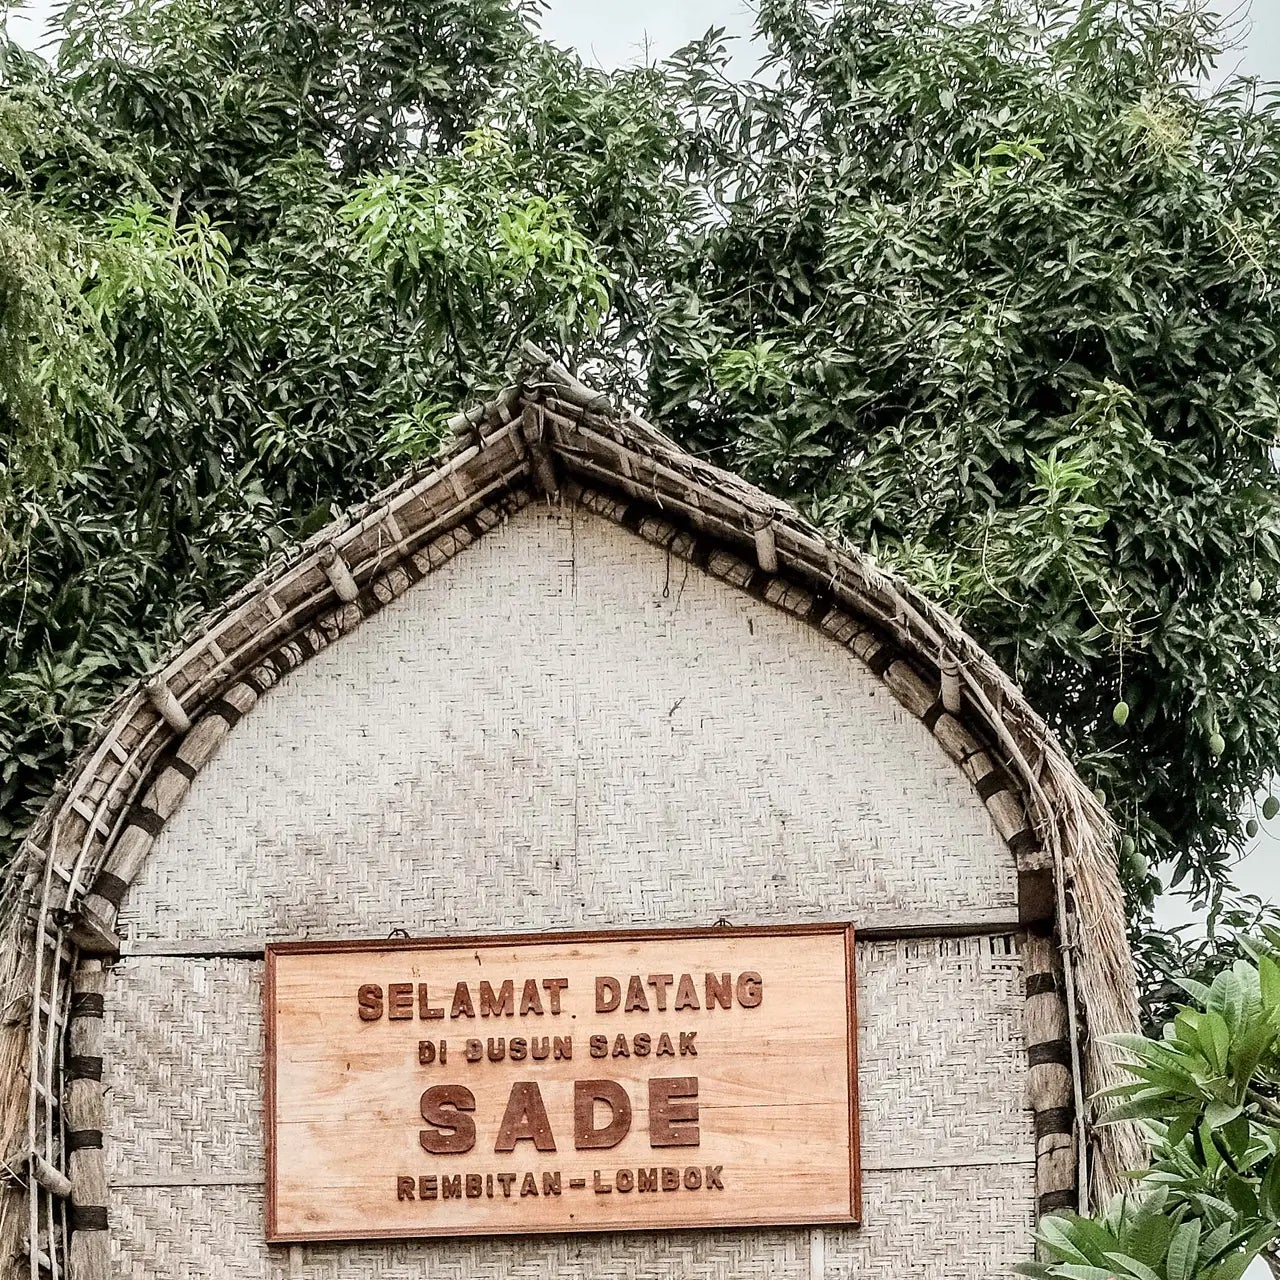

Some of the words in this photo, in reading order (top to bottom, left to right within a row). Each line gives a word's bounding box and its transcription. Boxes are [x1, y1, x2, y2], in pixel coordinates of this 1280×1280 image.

[357, 978, 569, 1021] SELAMAT
[595, 970, 763, 1015] DATANG
[418, 1039, 447, 1064] DI
[465, 1035, 573, 1063] DUSUN
[589, 1030, 698, 1058] SASAK
[418, 1076, 700, 1154] SADE
